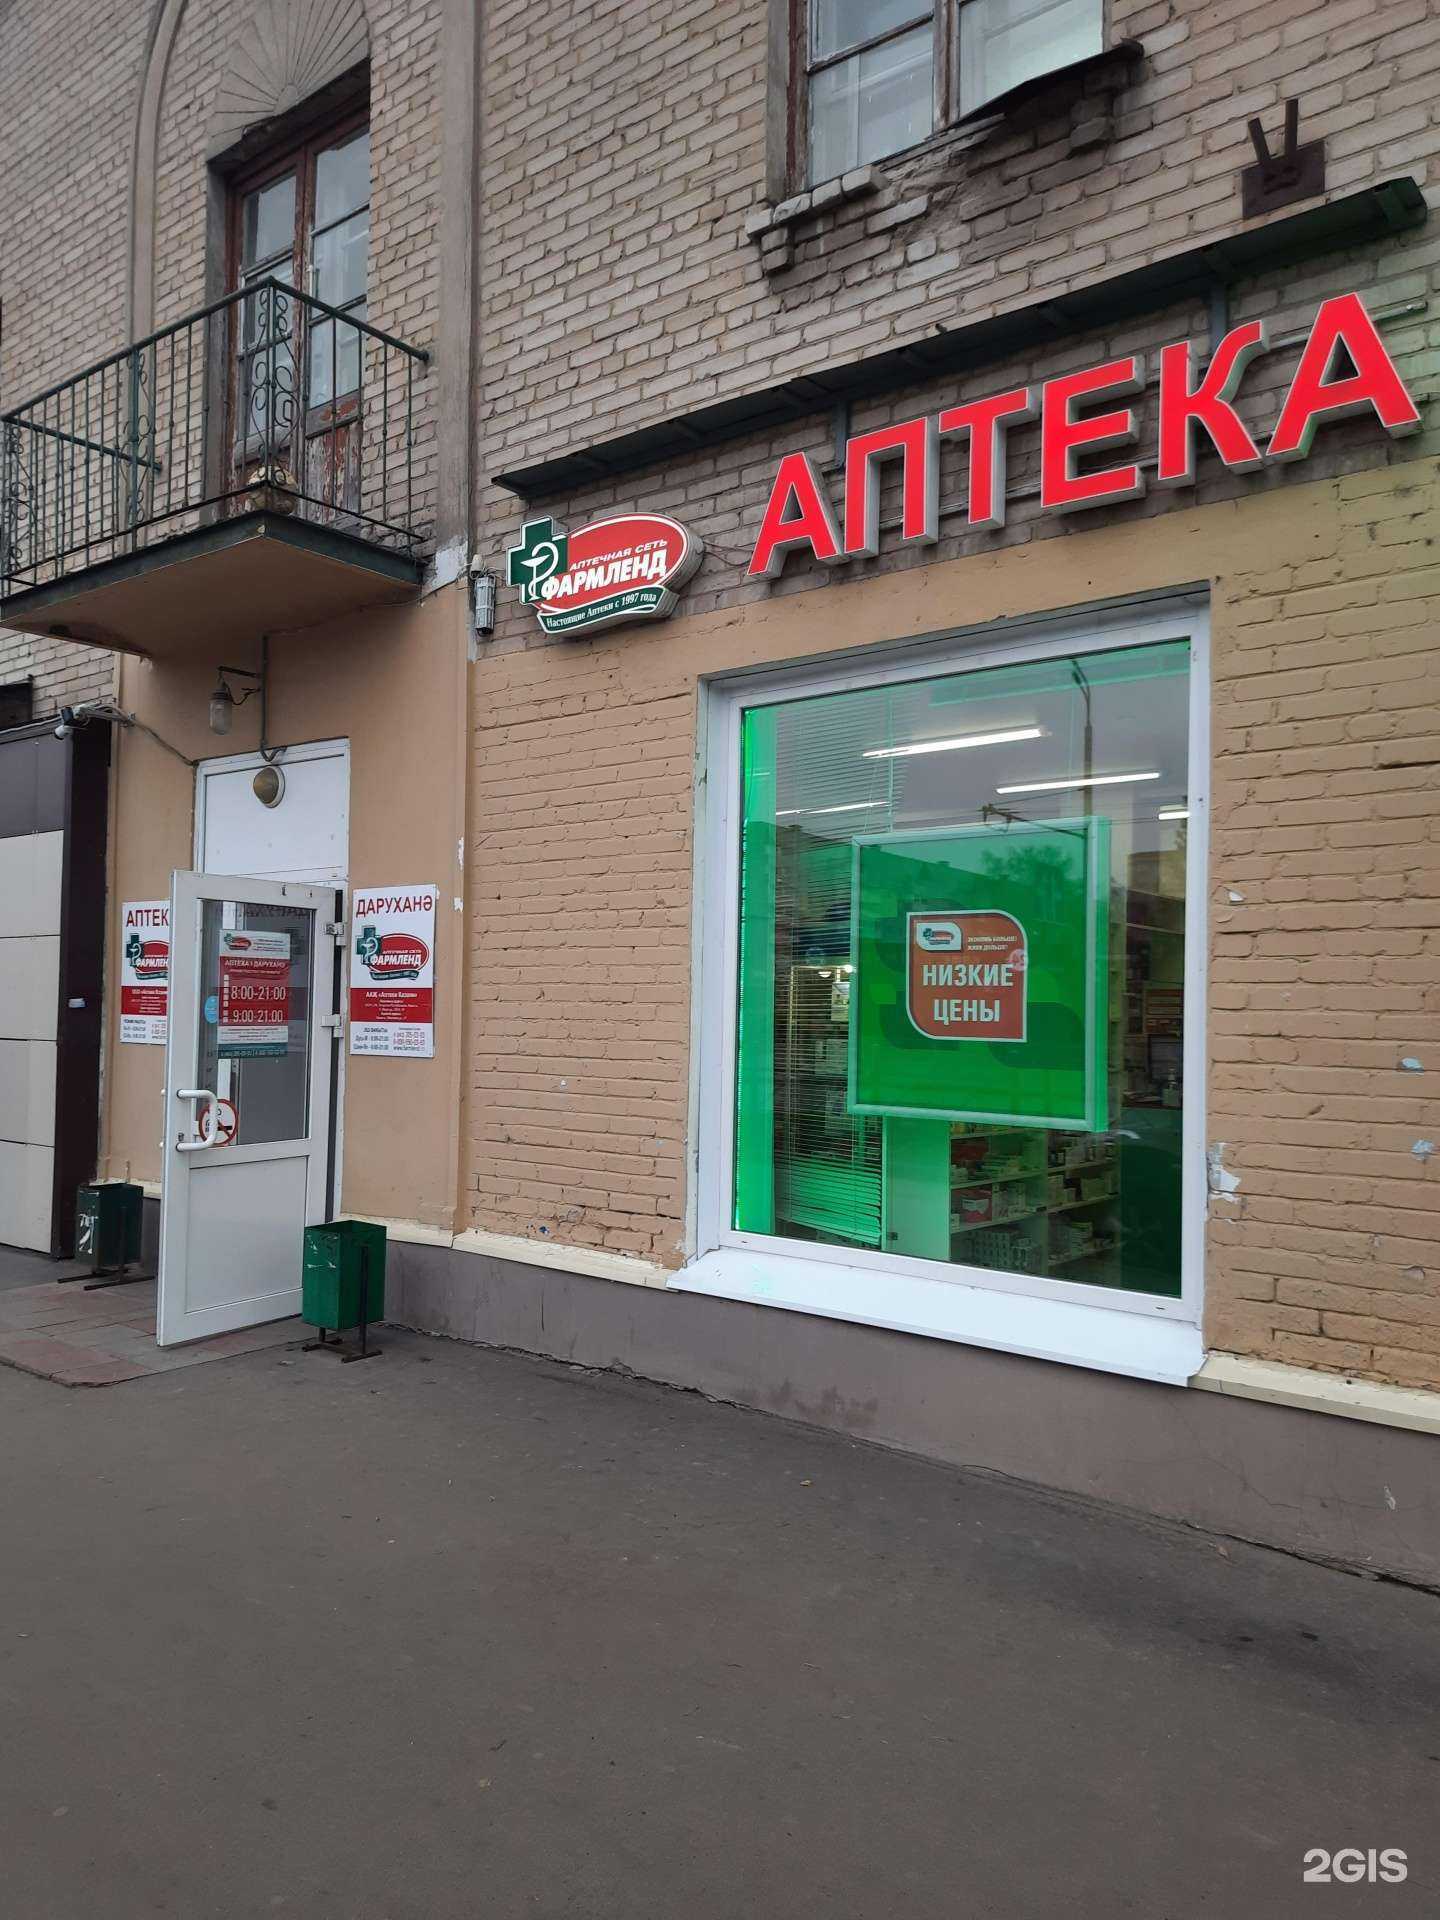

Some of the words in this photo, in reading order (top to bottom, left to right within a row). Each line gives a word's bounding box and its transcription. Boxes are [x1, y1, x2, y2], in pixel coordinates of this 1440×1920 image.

[746, 291, 1421, 578] АПТЕКА
[569, 548, 631, 571] АПТЕЧНАЯ
[635, 539, 668, 554] СЕТЬ
[541, 549, 667, 600] ФАРМЛЕНД
[546, 611, 586, 628] Настоящие
[587, 604, 614, 618] Аптеки
[621, 592, 640, 606] 1997
[640, 592, 657, 603] года
[125, 908, 169, 928] АПТЕК
[356, 895, 433, 918] ДАРУХАНӘ
[135, 958, 169, 968] ФАРМЛЕН
[370, 954, 422, 967] ФАРМЛЕНД
[921, 963, 1014, 987] НИЗКИЕ
[933, 999, 1000, 1026] ЦЕНЫ
